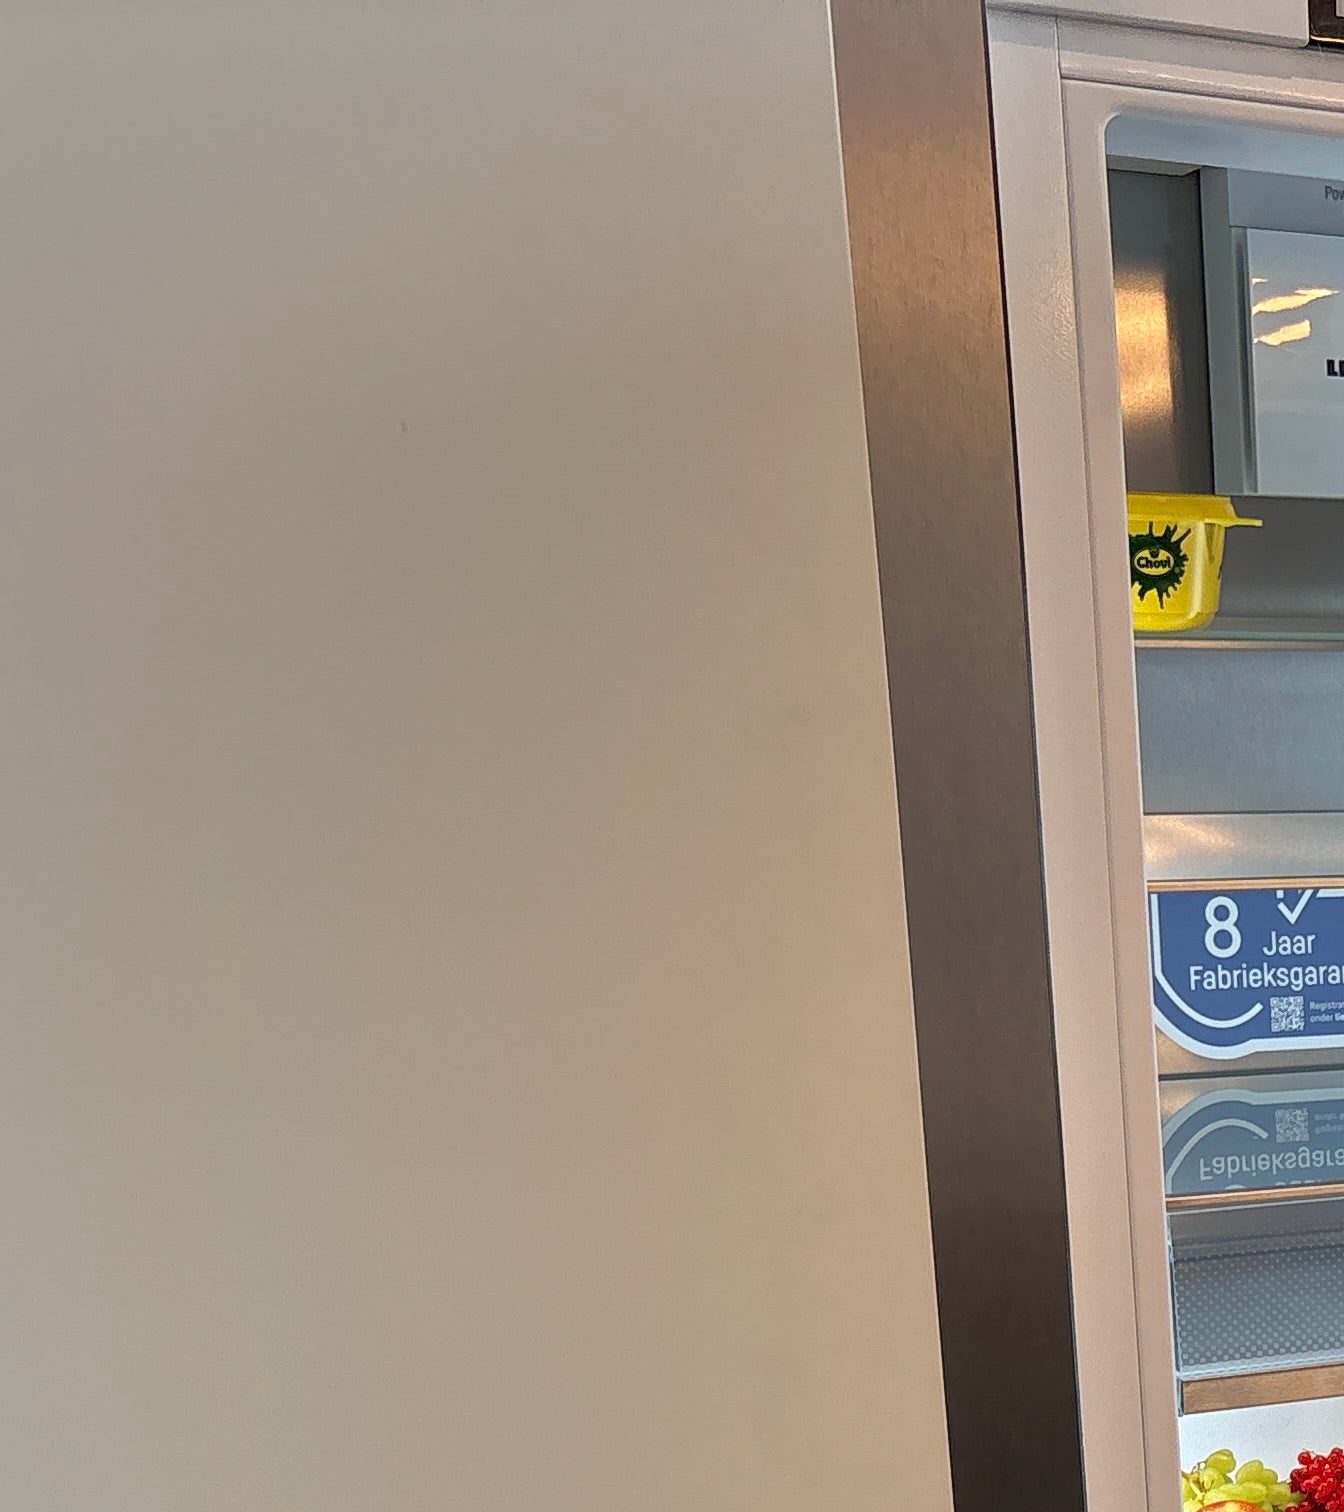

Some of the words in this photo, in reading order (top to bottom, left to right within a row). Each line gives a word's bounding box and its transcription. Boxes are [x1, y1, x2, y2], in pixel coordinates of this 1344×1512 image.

[1204, 895, 1243, 960] 8
[1262, 930, 1317, 957] Jaar
[1310, 1013, 1334, 1023] onder
